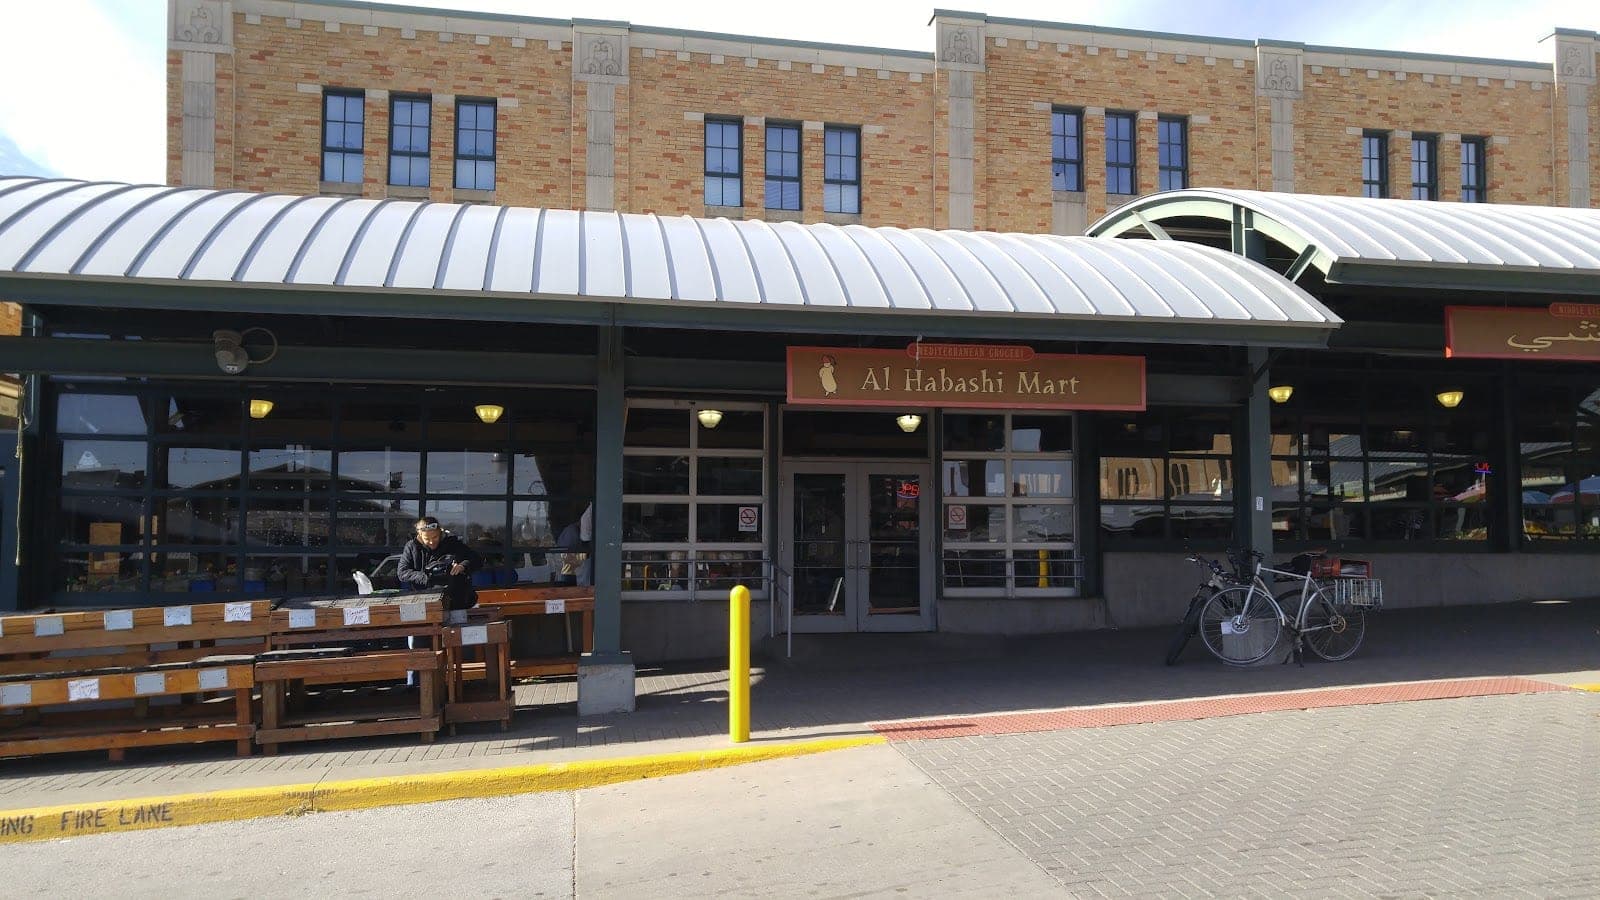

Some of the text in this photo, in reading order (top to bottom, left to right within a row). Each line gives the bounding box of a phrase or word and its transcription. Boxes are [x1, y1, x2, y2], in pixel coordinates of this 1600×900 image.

[861, 366, 1081, 395] Al Habashi Mart
[60, 808, 108, 831] FIRE
[119, 802, 174, 826] LANE
